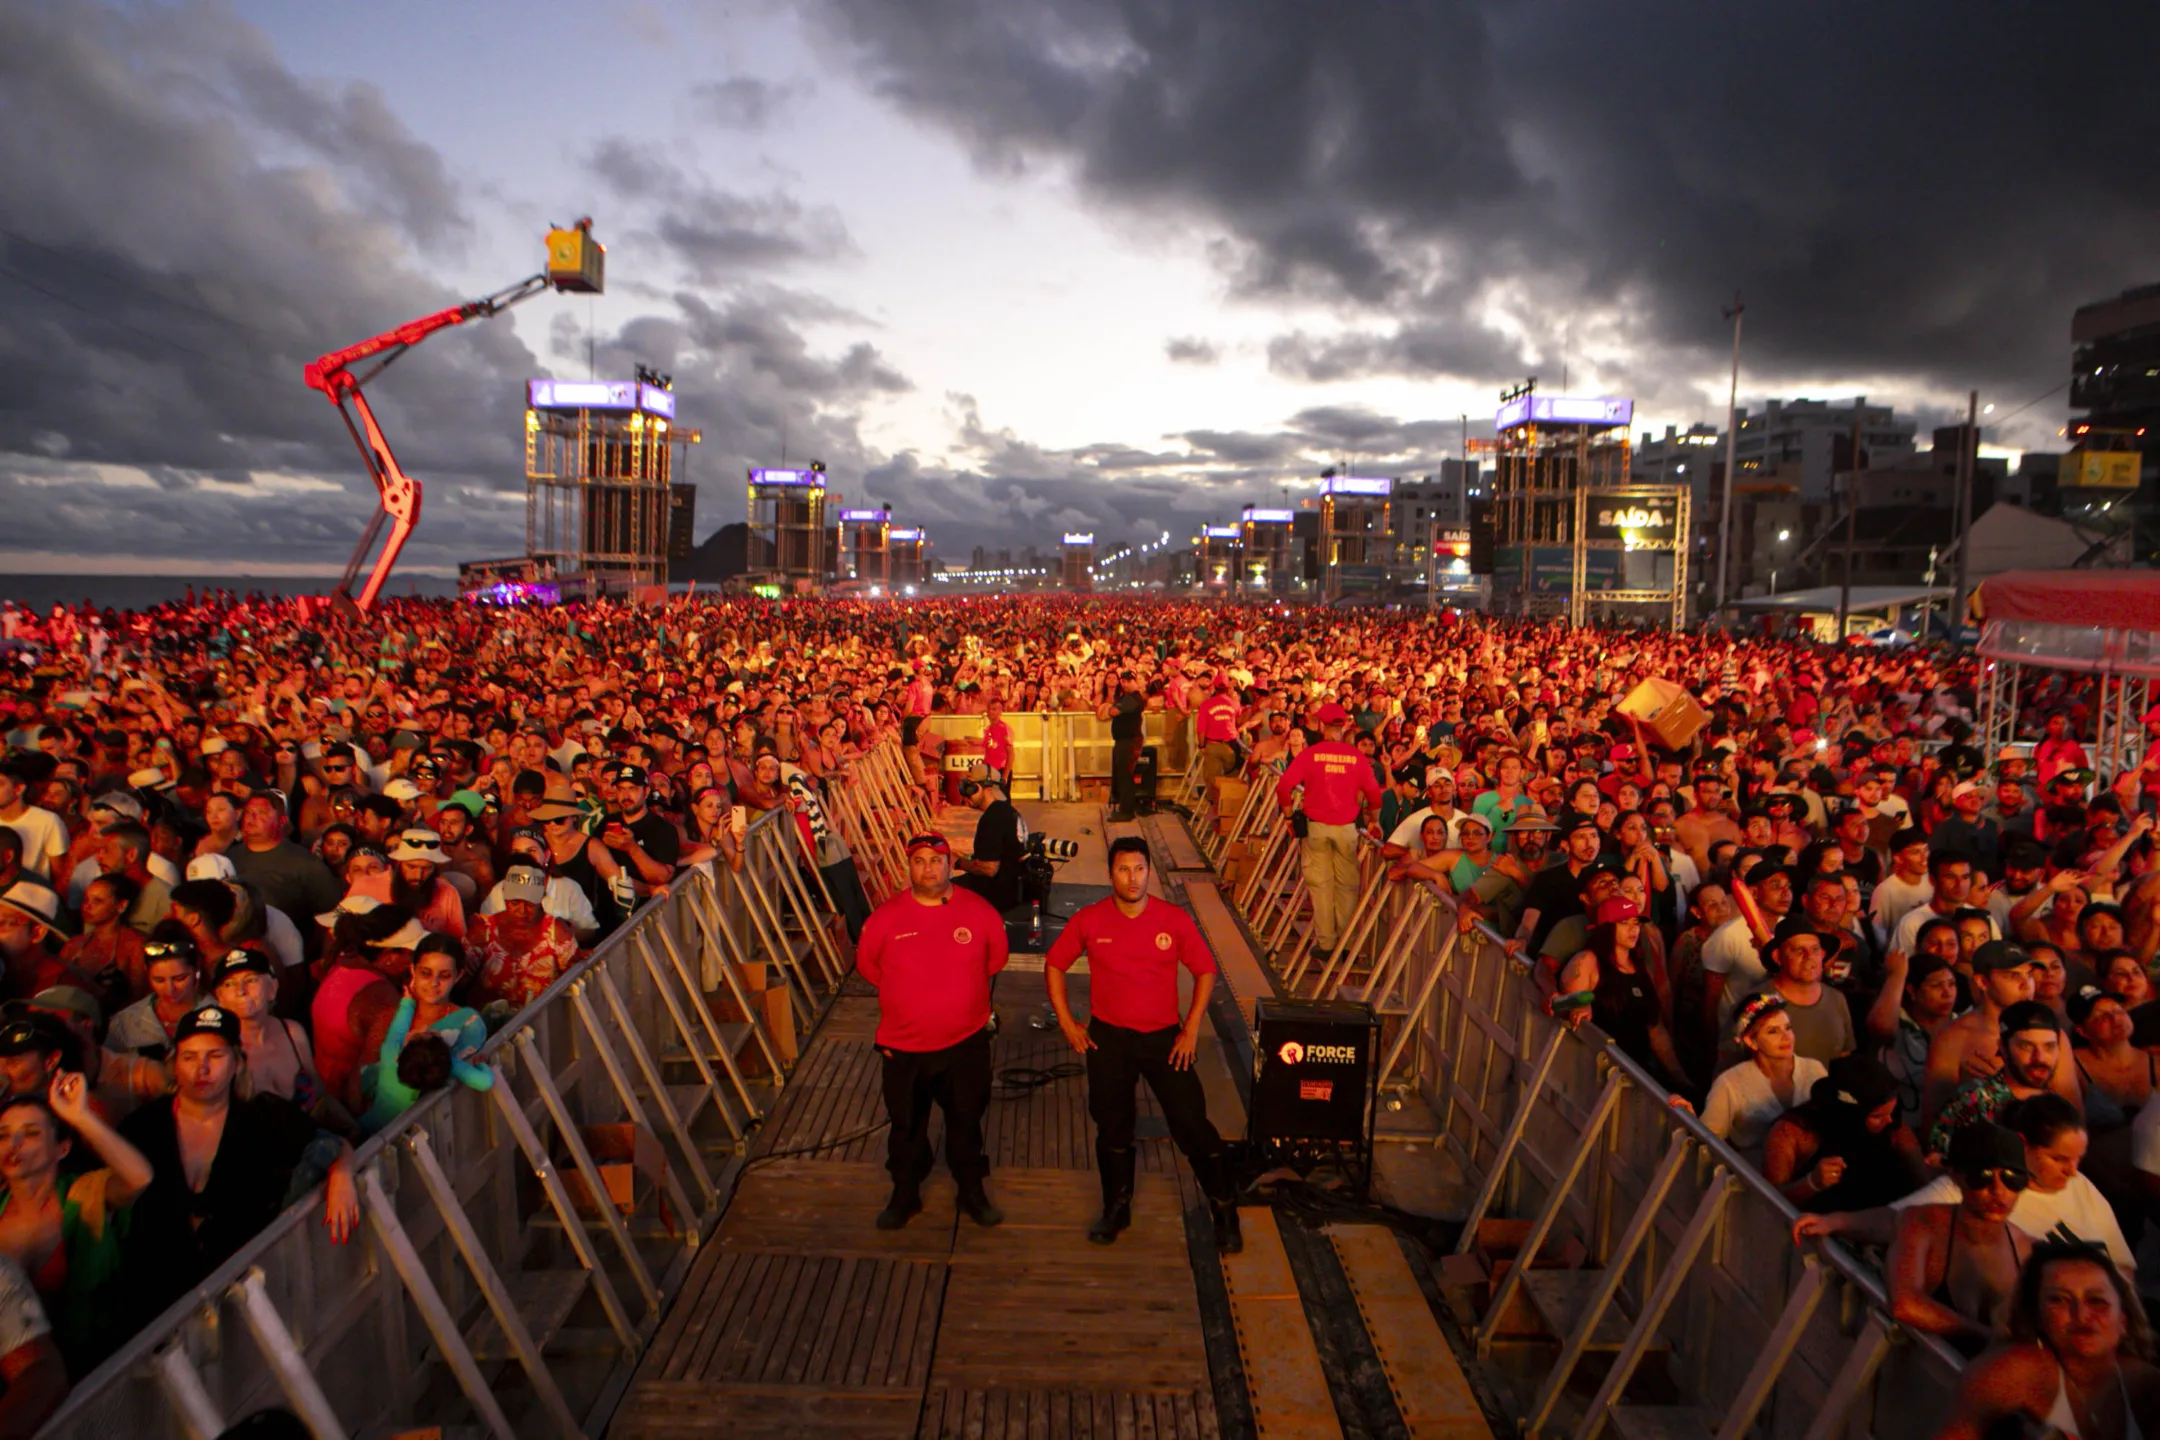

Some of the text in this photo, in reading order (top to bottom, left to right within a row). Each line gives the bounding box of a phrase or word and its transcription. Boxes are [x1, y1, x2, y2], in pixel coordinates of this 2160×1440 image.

[1599, 505, 1664, 528] SAÍDA
[1443, 529, 1470, 541] SAÍD
[1314, 753, 1357, 764] BOMBEIRO
[1325, 764, 1346, 774] CIVIL
[1307, 1045, 1356, 1059] FORCE
